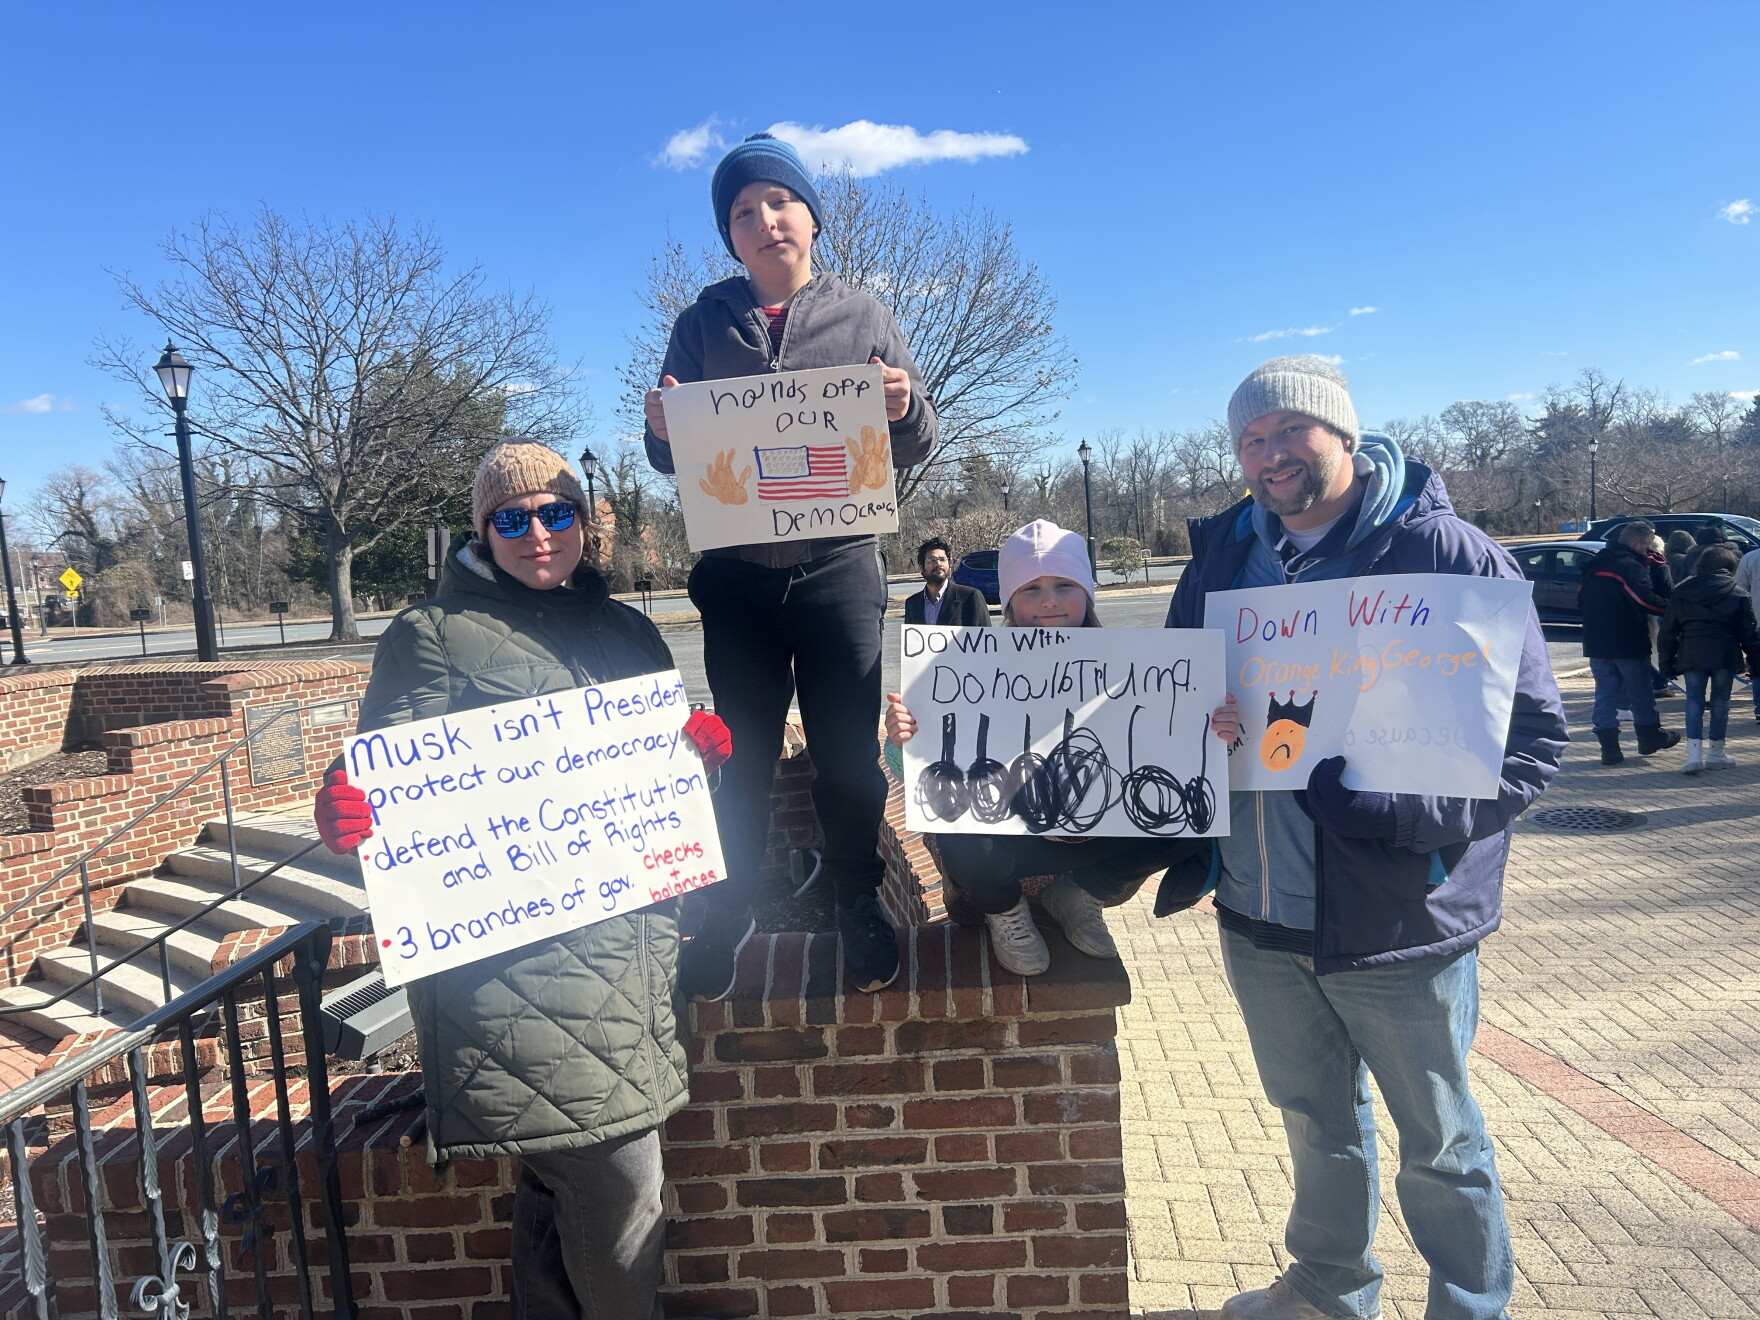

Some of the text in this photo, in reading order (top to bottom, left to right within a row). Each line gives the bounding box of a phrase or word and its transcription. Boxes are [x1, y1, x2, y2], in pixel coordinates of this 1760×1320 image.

[776, 411, 838, 432] OUR
[1349, 589, 1430, 627] With
[1239, 656, 1321, 693] Orange
[1328, 648, 1377, 692] King
[350, 717, 472, 777] Musk
[491, 699, 564, 743] isn't
[585, 679, 686, 726] President
[367, 729, 679, 826] protect our democracy
[374, 771, 704, 871] defend the Constitution
[442, 809, 682, 889] and Bill of Rights
[643, 841, 704, 870] checks
[649, 870, 718, 903] balances
[396, 874, 636, 960] 3 branches of gov.
